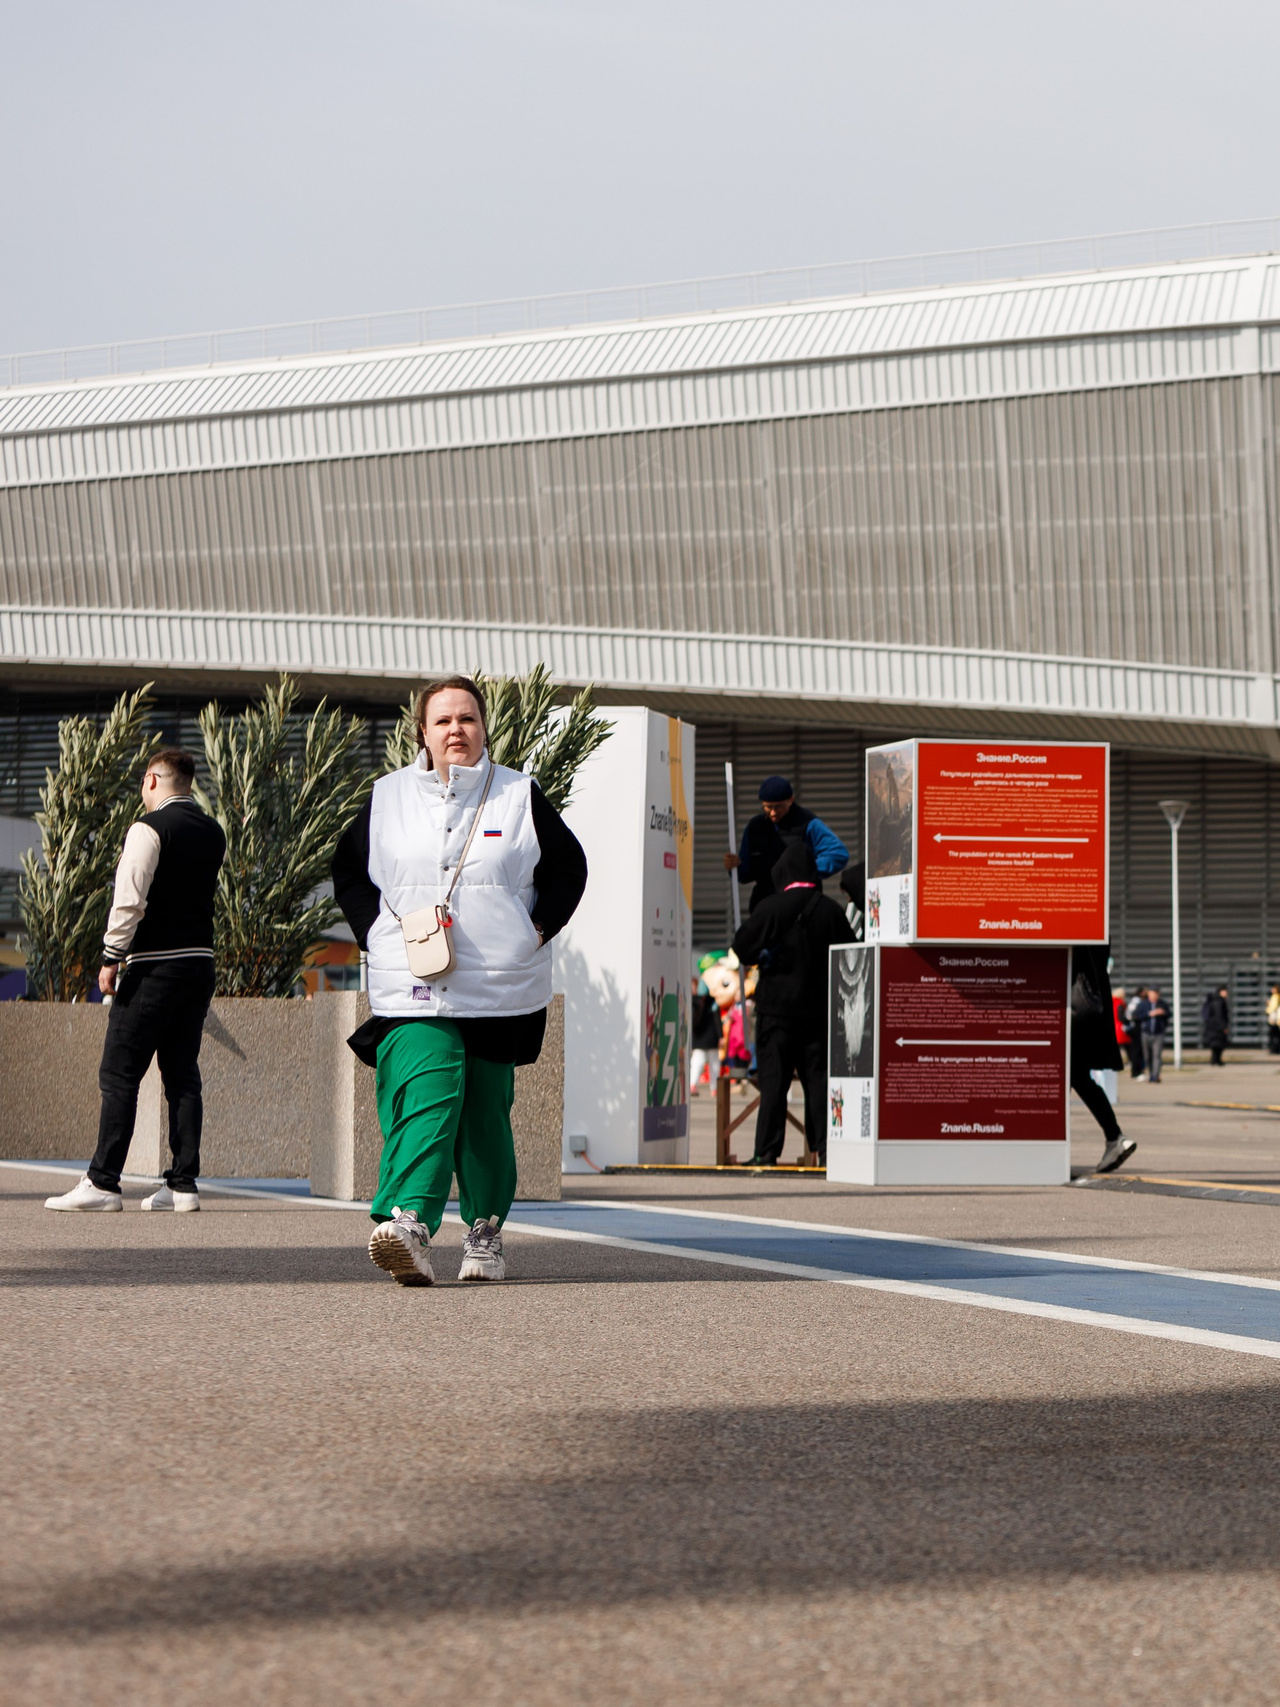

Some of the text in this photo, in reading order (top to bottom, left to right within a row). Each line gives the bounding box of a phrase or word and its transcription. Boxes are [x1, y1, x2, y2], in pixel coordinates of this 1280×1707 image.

[976, 752, 1048, 764] Знание.Россия
[978, 919, 1043, 930] Znanie.Russia
[939, 956, 1009, 967] Знание.Россия
[941, 1122, 1005, 1134] Znanie.Russia
